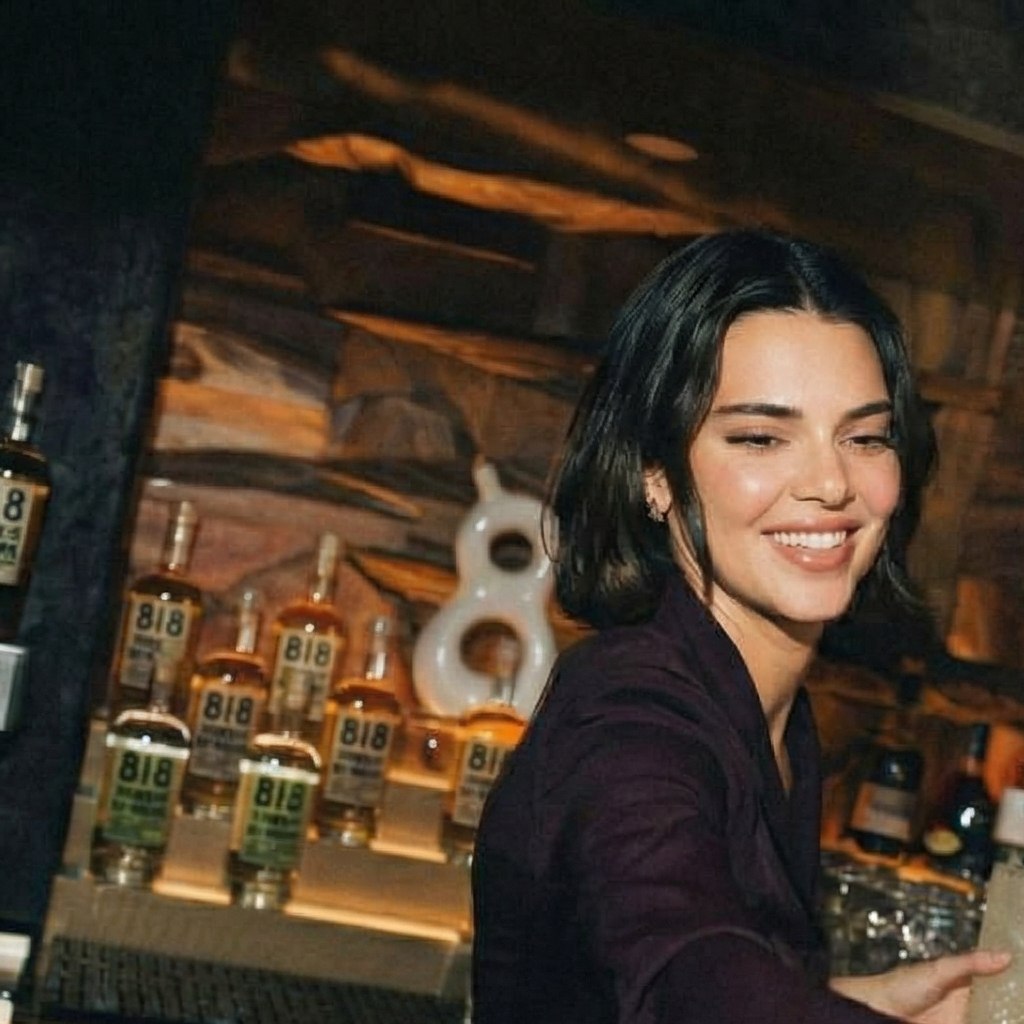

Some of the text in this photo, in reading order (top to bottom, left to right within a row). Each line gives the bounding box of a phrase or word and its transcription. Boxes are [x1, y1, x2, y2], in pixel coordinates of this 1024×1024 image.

[136, 603, 185, 637] 818
[284, 635, 331, 667] 818
[204, 691, 252, 724] 818
[340, 717, 391, 750] 818
[119, 751, 174, 787] 818
[255, 777, 306, 811] 818
